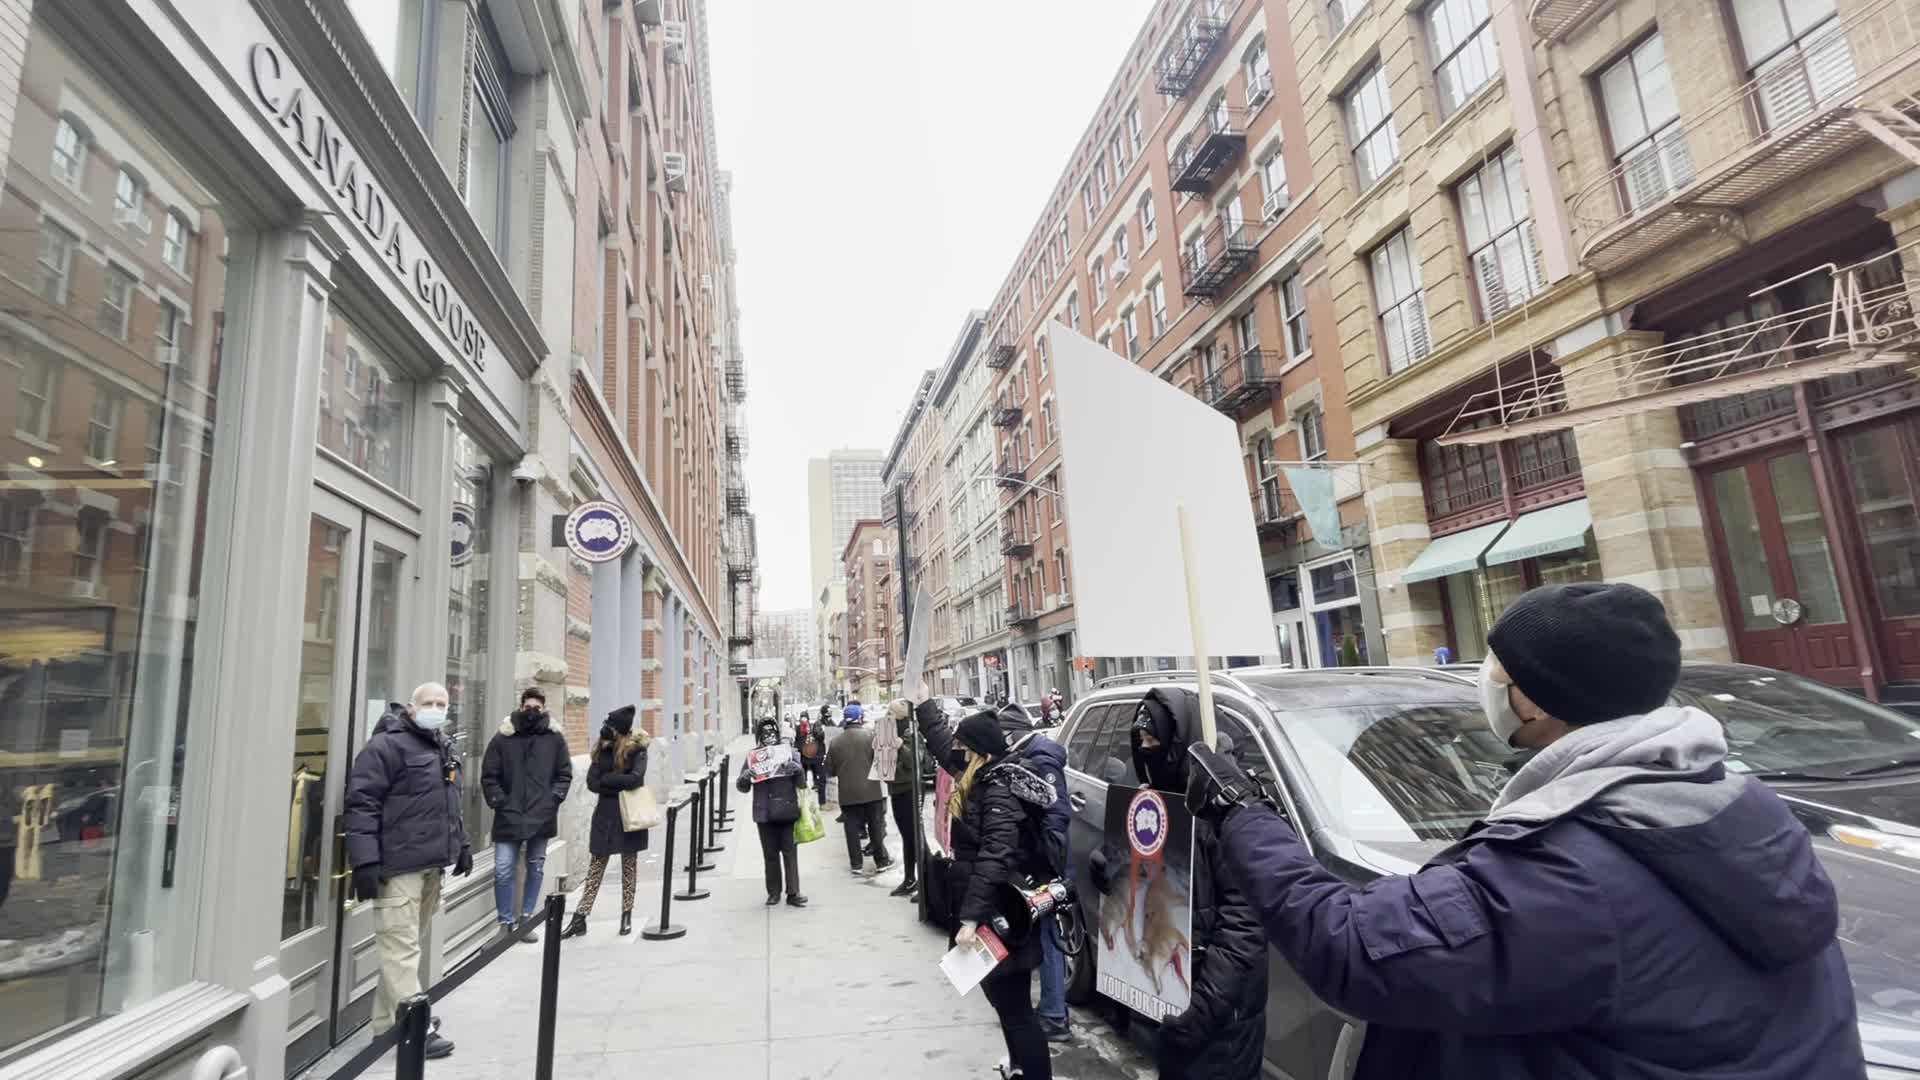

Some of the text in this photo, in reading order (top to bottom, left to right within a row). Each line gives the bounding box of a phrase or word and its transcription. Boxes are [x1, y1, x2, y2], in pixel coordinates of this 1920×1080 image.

[250, 42, 487, 373] CANADA GOOSE
[1103, 974, 1129, 1004] YOUR
[1129, 986, 1151, 1015] FUR
